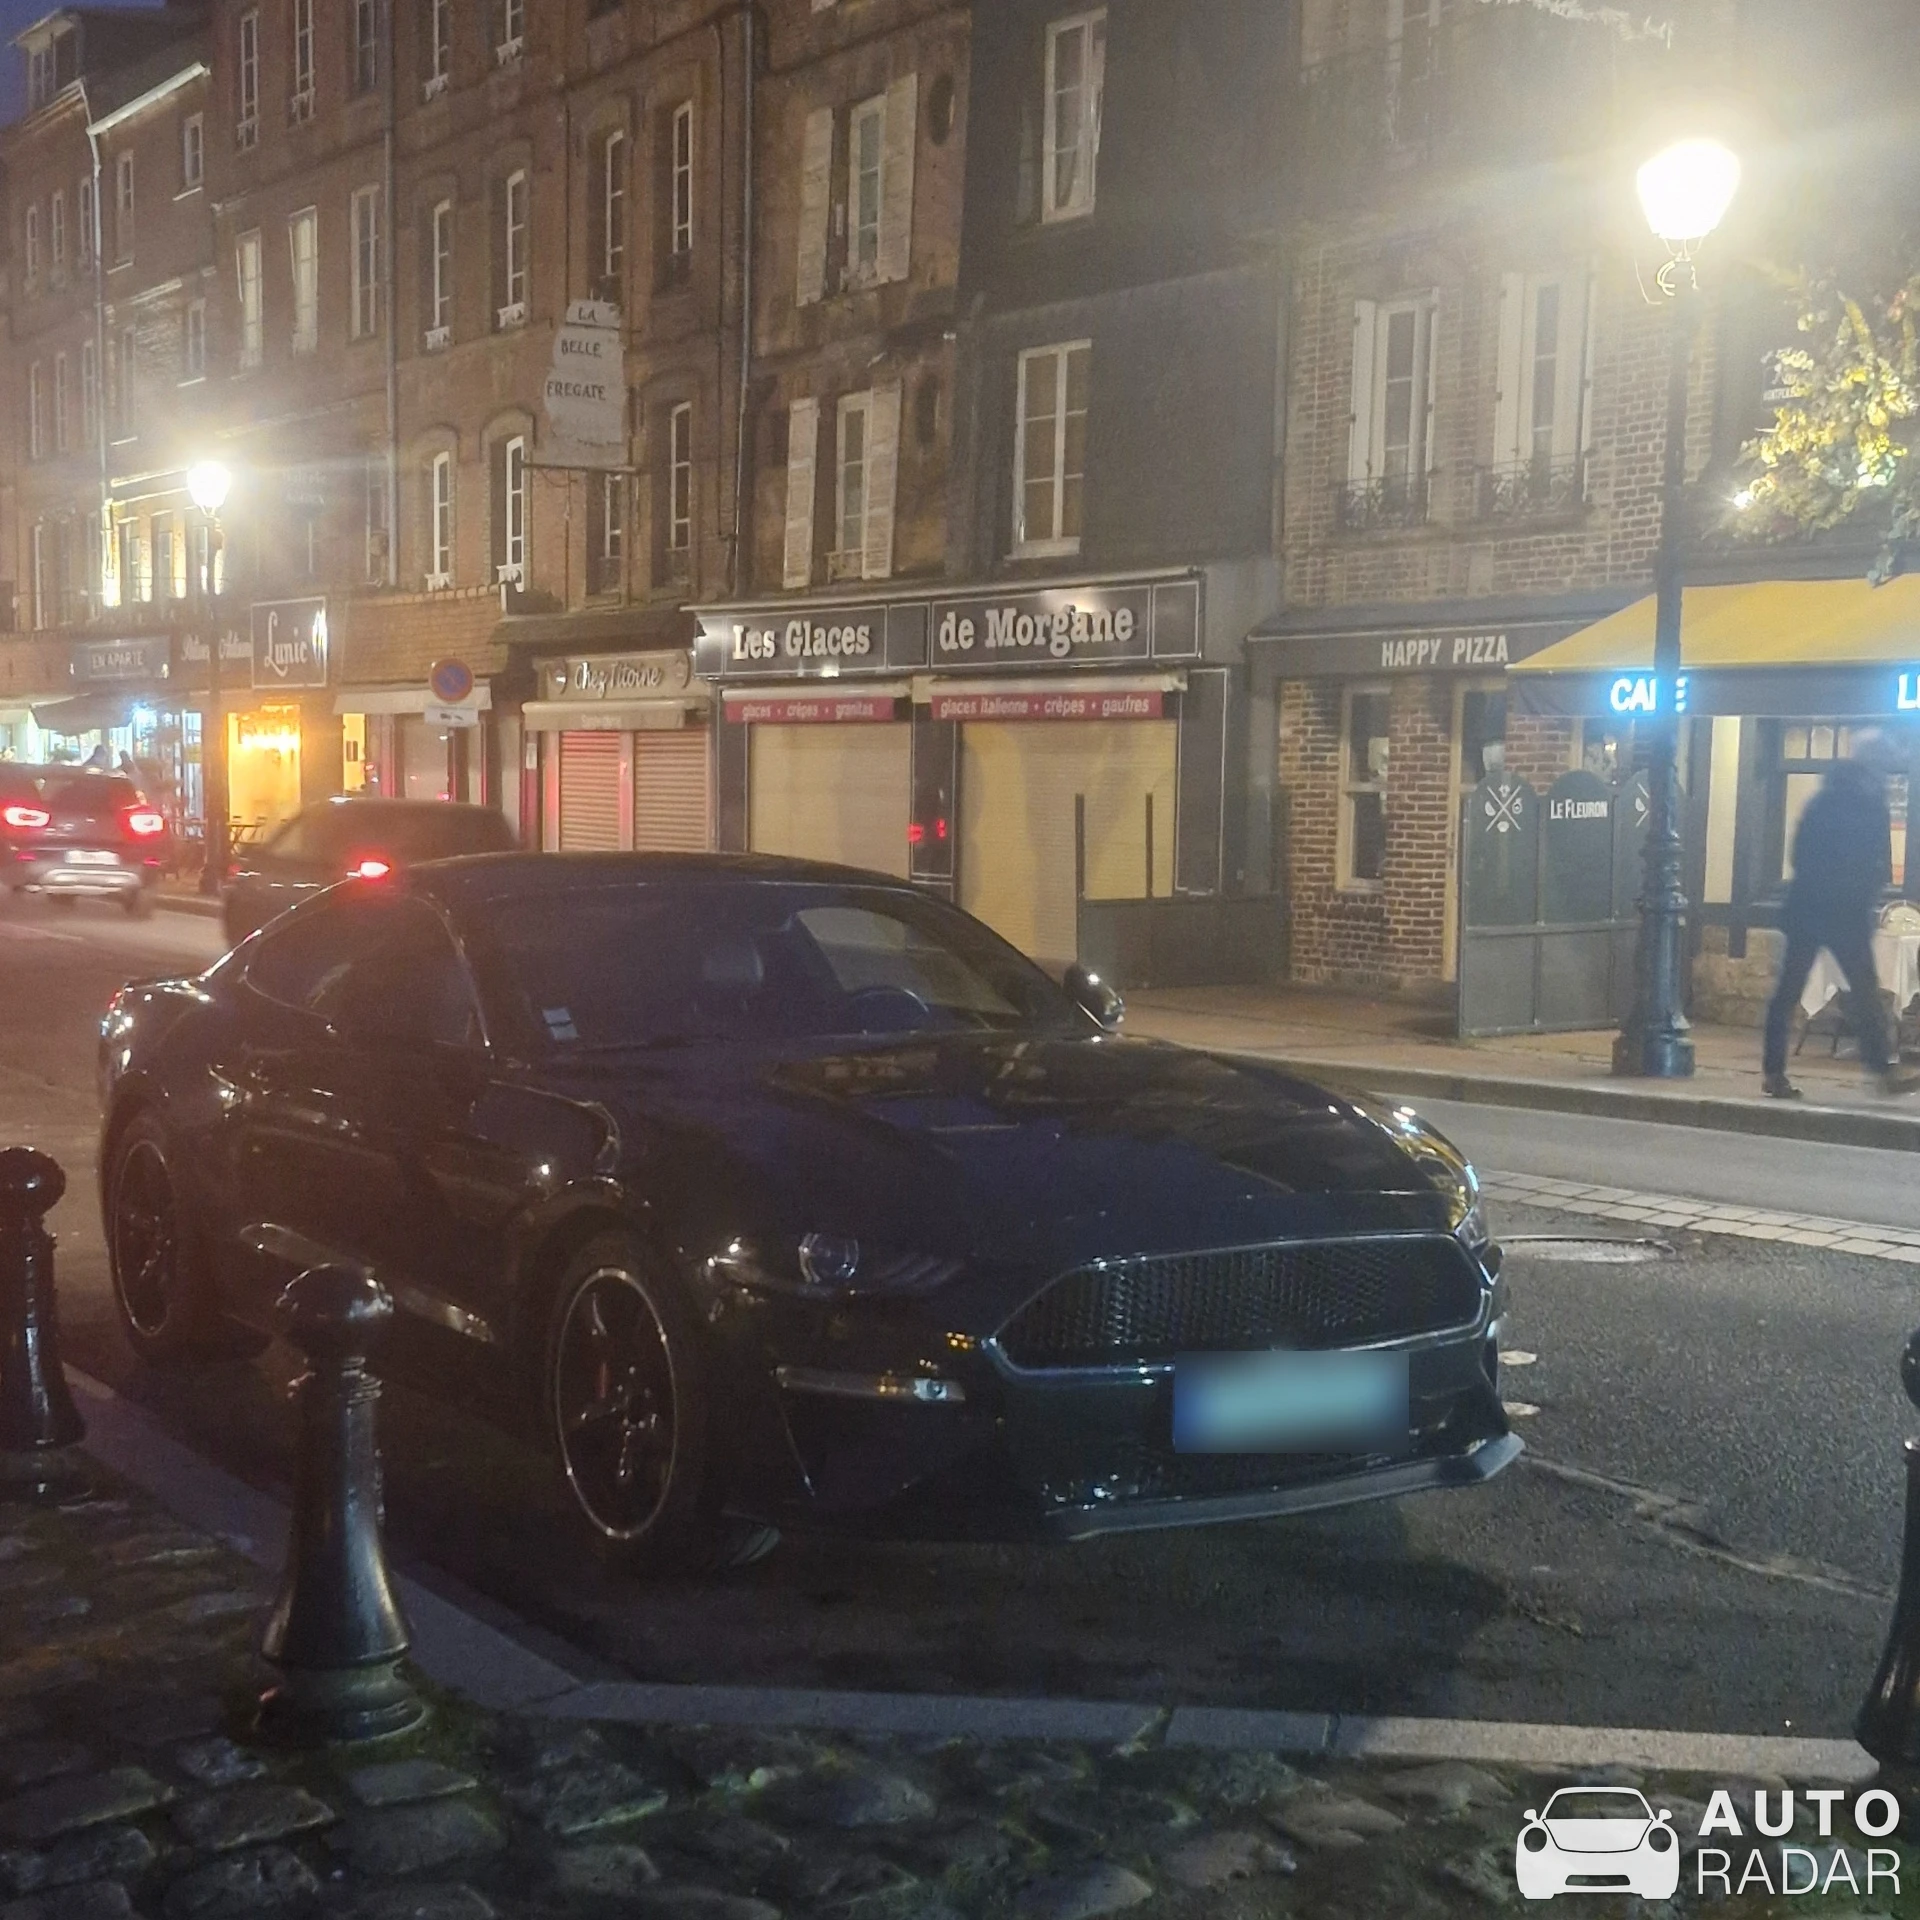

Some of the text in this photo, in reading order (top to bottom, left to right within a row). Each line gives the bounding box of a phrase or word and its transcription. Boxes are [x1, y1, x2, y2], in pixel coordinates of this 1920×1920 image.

[578, 307, 597, 323] LA
[561, 339, 602, 358] BELLE
[546, 380, 606, 401] FREGATE
[732, 620, 870, 660] Les Glaces
[939, 604, 1133, 657] de Morgane
[1382, 635, 1509, 667] HAPPY PIZZA
[575, 662, 607, 698] Chez
[940, 698, 977, 718] glaces
[1044, 697, 1085, 716] crêpes
[1102, 695, 1149, 717] gaufres
